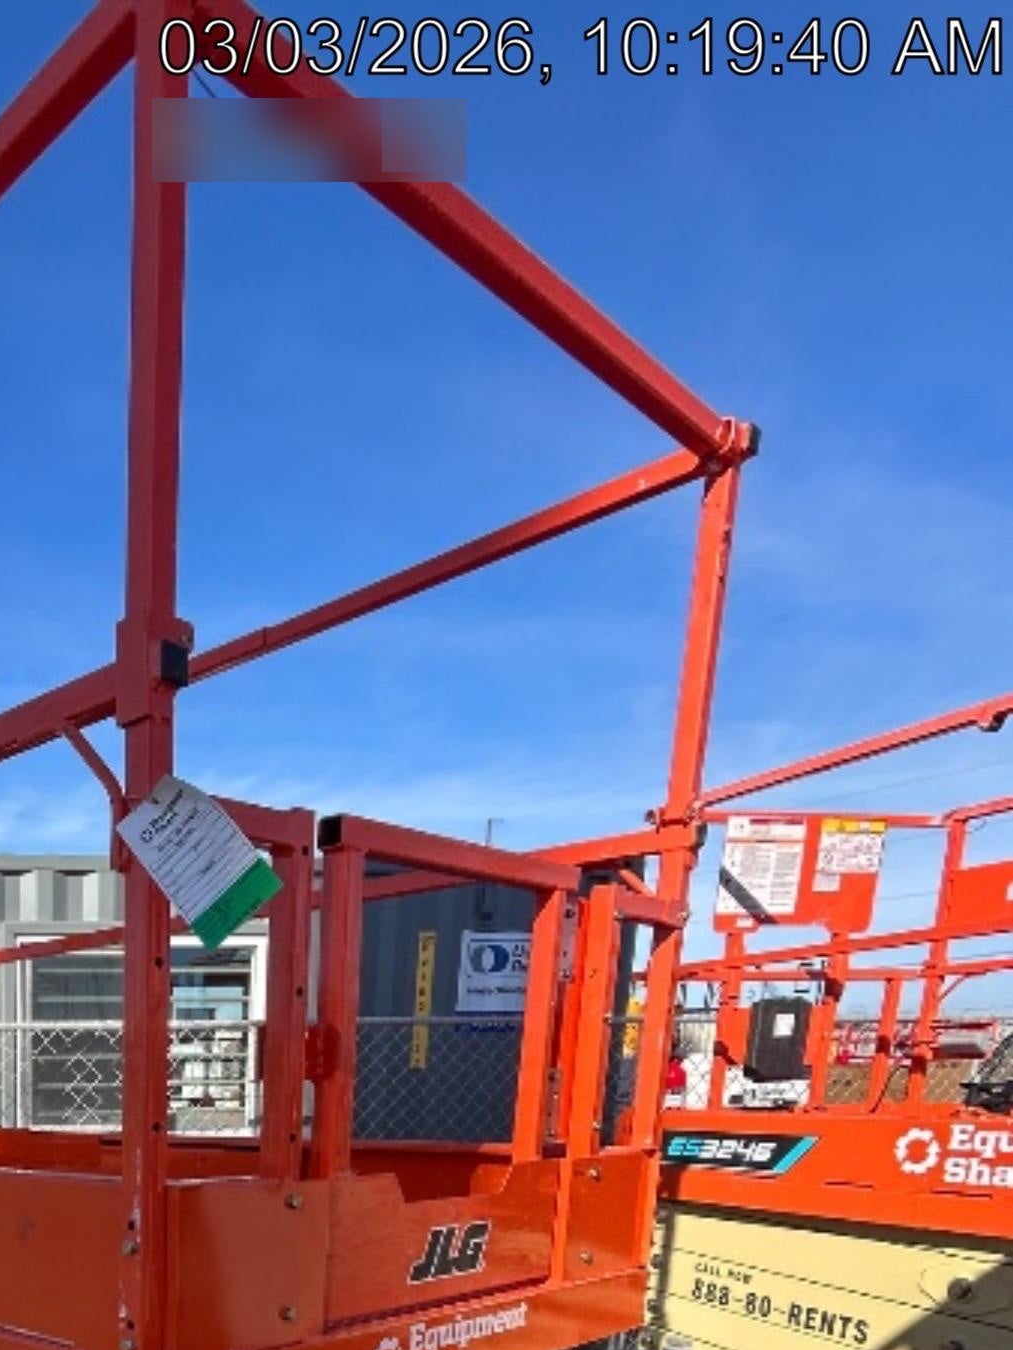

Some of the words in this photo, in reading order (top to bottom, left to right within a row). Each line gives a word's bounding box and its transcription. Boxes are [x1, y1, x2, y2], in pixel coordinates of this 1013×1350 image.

[667, 1136, 777, 1162] ES3246
[407, 1220, 491, 1285] JLG
[691, 1277, 870, 1345] 888-80-RENTS
